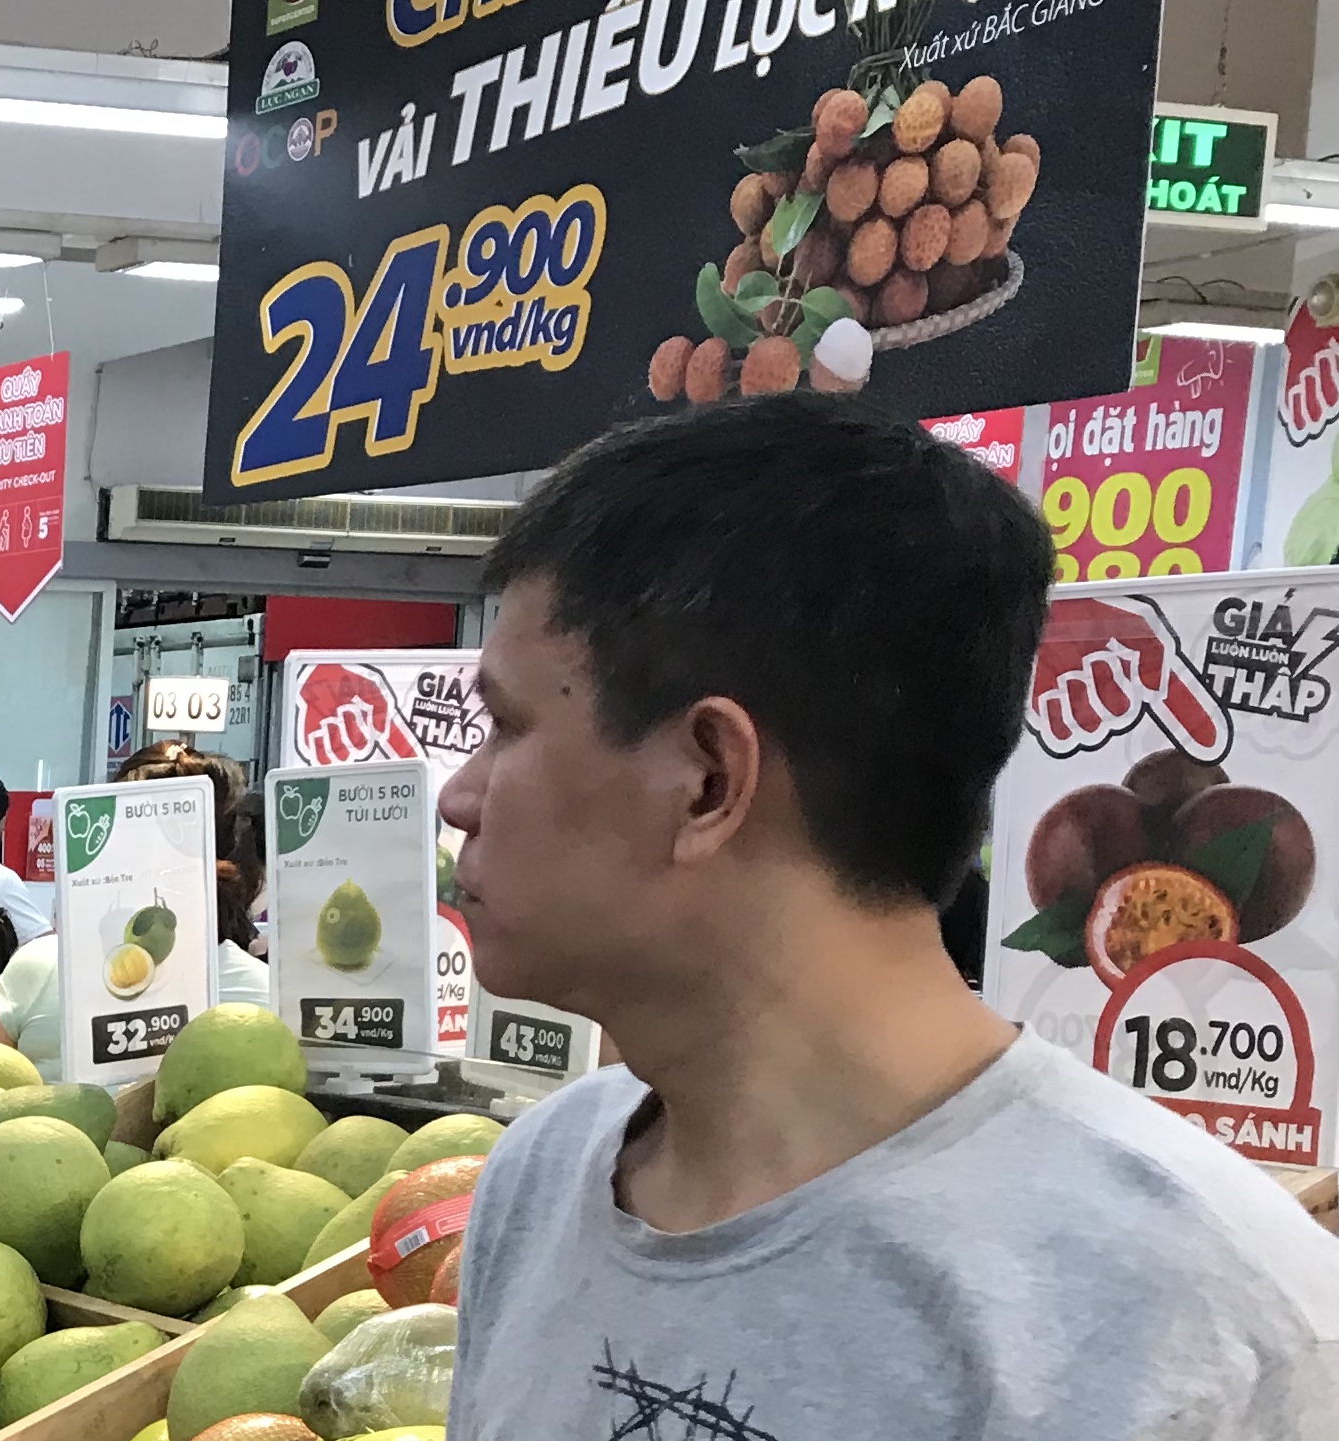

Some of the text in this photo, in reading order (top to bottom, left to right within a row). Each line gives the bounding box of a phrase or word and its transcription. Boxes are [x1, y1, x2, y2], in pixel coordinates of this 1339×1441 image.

[899, 36, 951, 72] Xuất
[952, 22, 980, 51] xứ
[982, 4, 1025, 43] BẮC
[1148, 118, 1228, 167] IT
[1148, 175, 1247, 214] HOÁT
[452, 300, 580, 360] vnd/kg
[1045, 400, 1224, 471] ọi đặt hàng
[1042, 467, 1213, 550] 900
[1213, 588, 1297, 647] GIÁ
[153, 691, 177, 719] 03
[417, 667, 465, 705] GIÁ
[187, 692, 222, 720] 03
[162, 802, 169, 815] 5
[173, 800, 196, 814] ROI
[378, 786, 386, 800] 5
[390, 784, 416, 798] ROI
[149, 1034, 176, 1047] vnd/K
[1203, 1067, 1280, 1098] vnd/Kg
[1214, 1113, 1313, 1154] SÁNH
